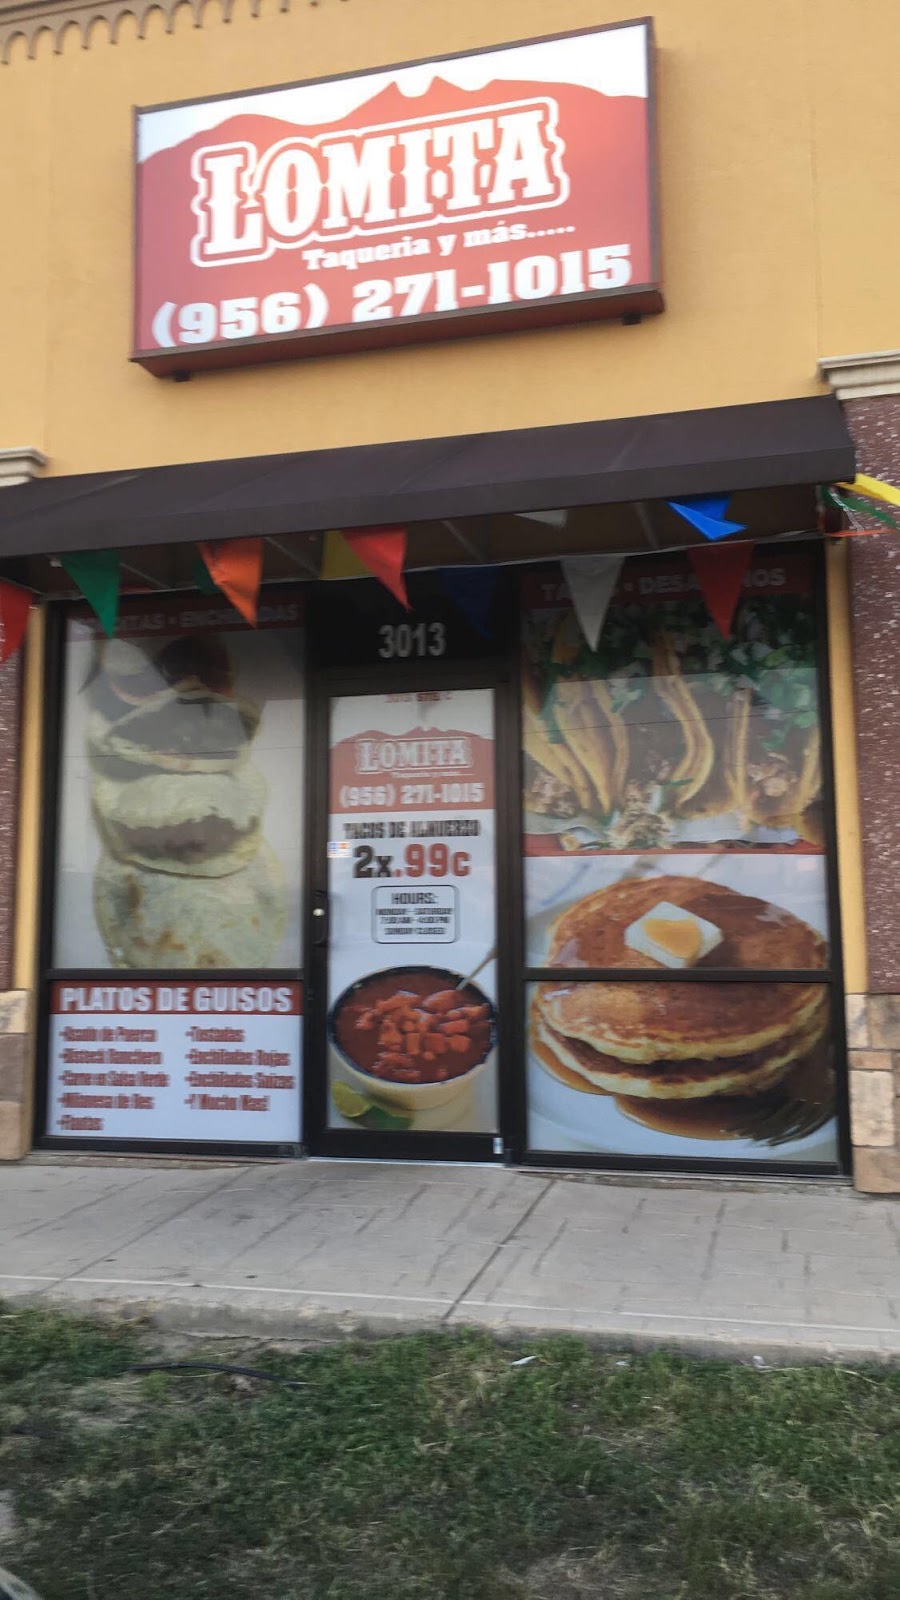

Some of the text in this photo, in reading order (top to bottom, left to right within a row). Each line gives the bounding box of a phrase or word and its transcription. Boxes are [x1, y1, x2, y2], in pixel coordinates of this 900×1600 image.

[200, 108, 556, 256] LOMITA
[302, 235, 431, 271] Taqueria
[437, 233, 458, 257] y
[151, 243, 633, 348] (956) 271-1015
[378, 622, 447, 658] 3013
[357, 738, 470, 773] LOMITA
[339, 782, 485, 808] (956) 271-1015
[388, 821, 407, 838] DE
[391, 892, 439, 905] HOURS:
[59, 986, 293, 1013] PLATOS DE GUISOS
